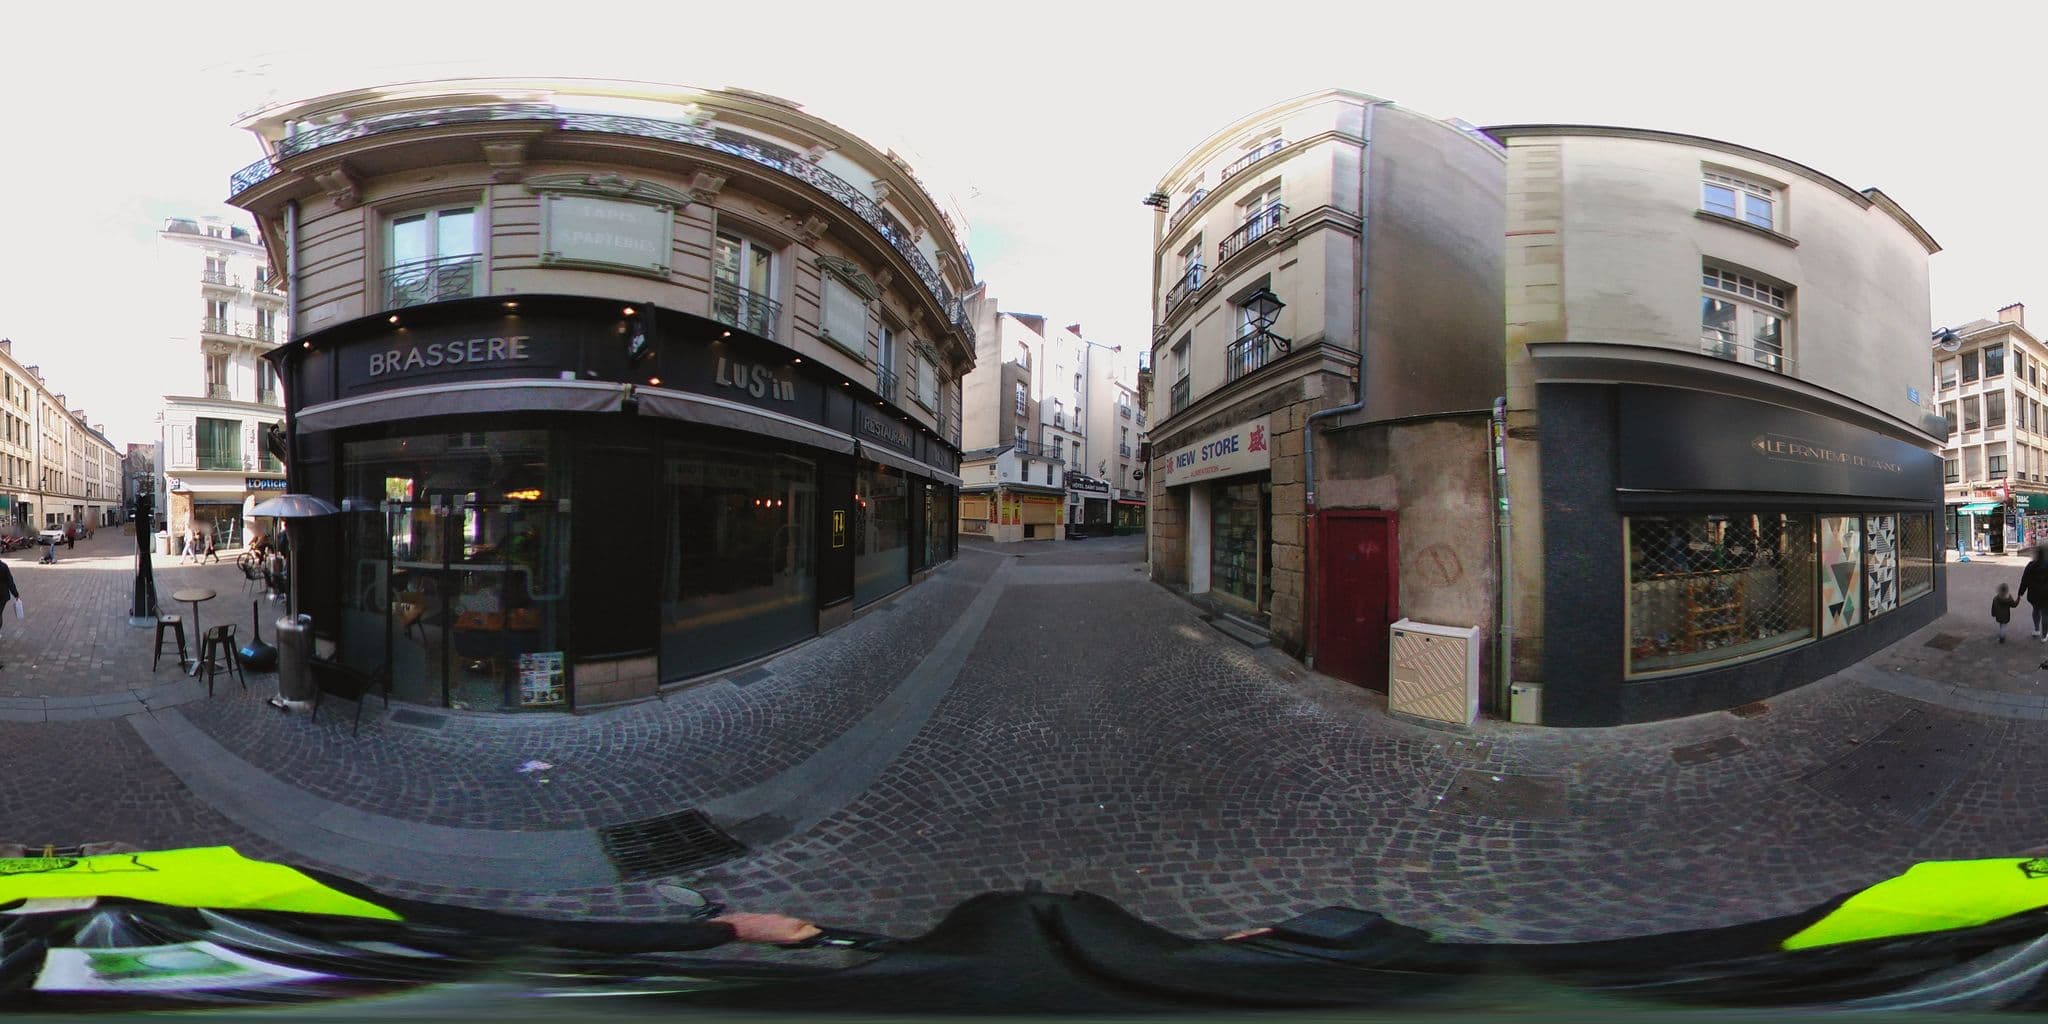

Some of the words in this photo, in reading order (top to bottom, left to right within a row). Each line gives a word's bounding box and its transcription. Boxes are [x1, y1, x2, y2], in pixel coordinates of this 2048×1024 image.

[369, 335, 530, 377] BRASSERE
[1176, 450, 1196, 469] NEW
[1201, 434, 1239, 461] STORE
[1767, 440, 1785, 453] LE
